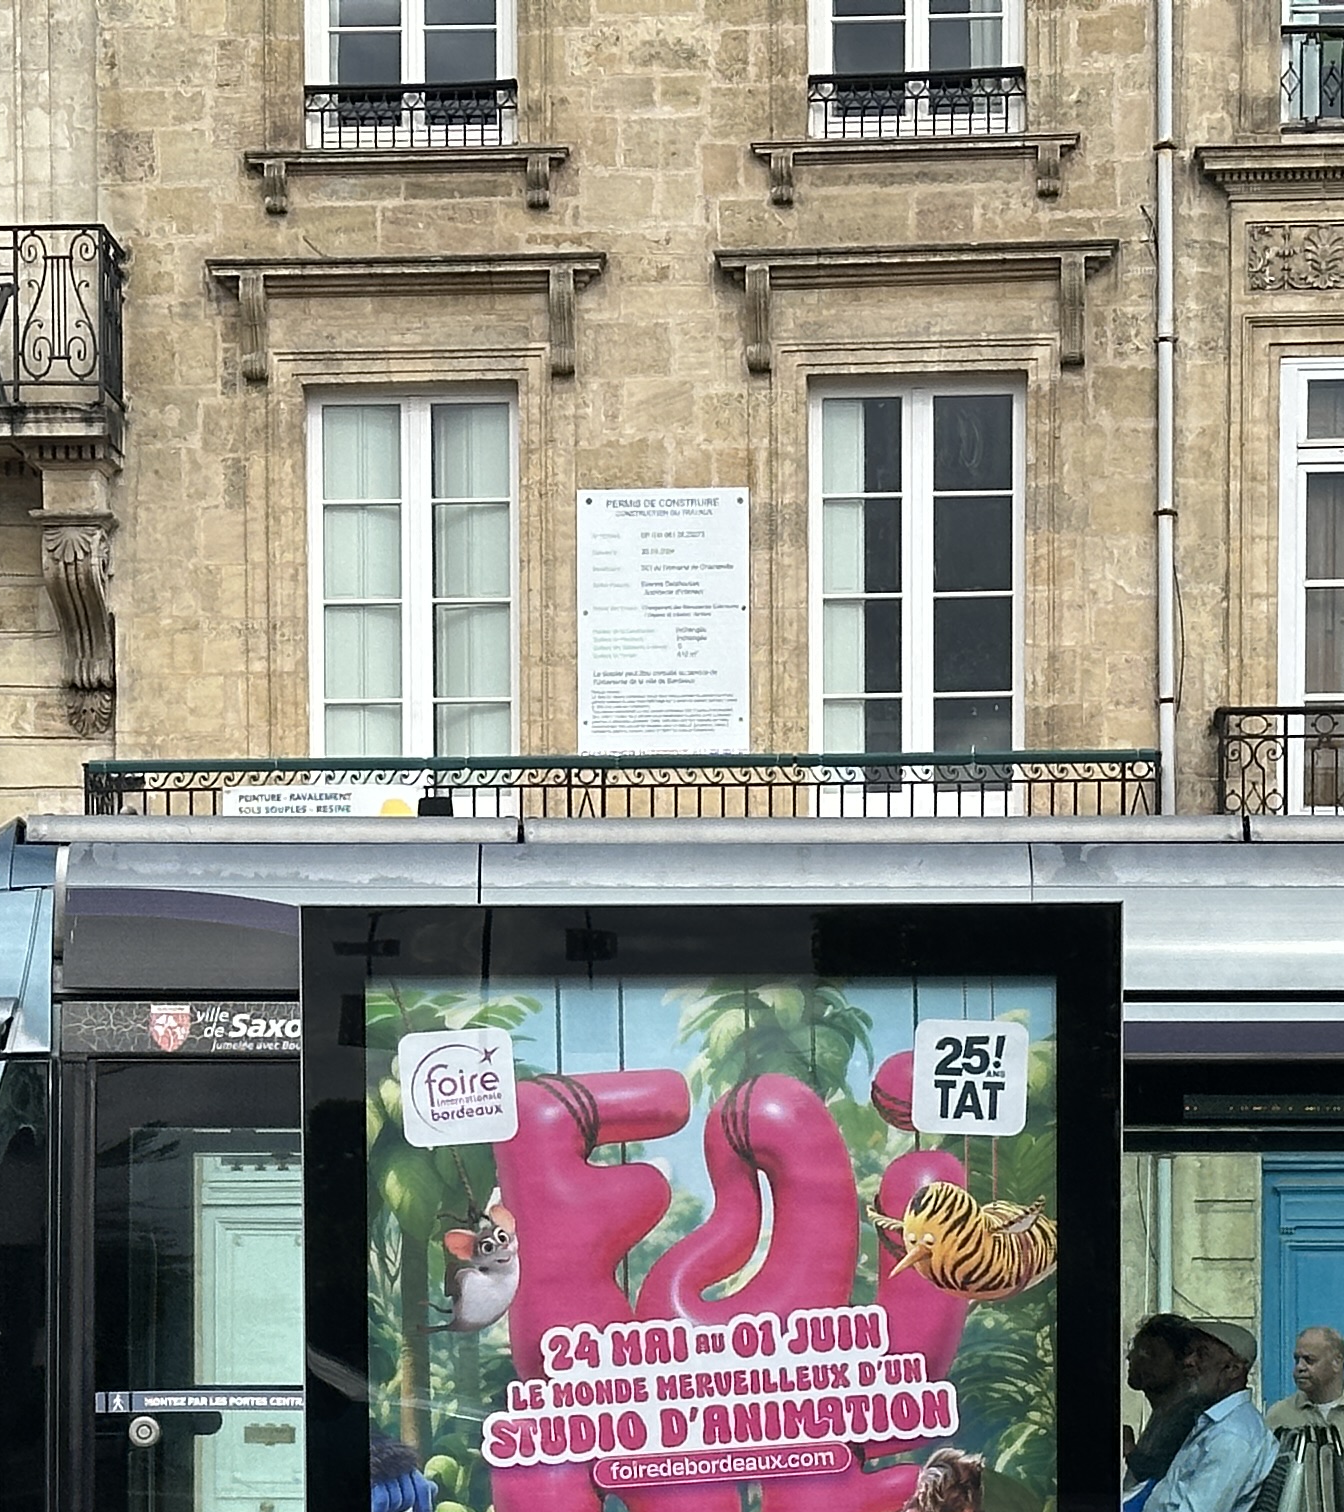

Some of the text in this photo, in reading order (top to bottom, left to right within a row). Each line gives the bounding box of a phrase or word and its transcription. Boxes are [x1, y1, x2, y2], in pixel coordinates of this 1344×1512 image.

[644, 499, 657, 507] DE
[238, 793, 282, 802] PEINTURE
[289, 793, 352, 801] RAVALEMENT
[265, 805, 307, 814] SOUPLES
[197, 1006, 230, 1023] ville
[203, 1013, 302, 1038] de Saxo
[256, 1041, 280, 1050] avec
[934, 1035, 1006, 1076] 25!
[986, 1070, 1006, 1078] ANS
[425, 1064, 500, 1107] foire
[437, 1092, 503, 1107] internationale
[934, 1079, 1006, 1120] TAT
[431, 1105, 504, 1121] bordeaux
[548, 1312, 882, 1371] 24 MAI AU 01 JUIN
[512, 1358, 922, 1411] LE MONDE MERVEILLEUX D'UN
[144, 1396, 186, 1407] MONTEZ
[188, 1396, 208, 1407] PAR
[209, 1396, 228, 1407] LES
[229, 1396, 268, 1407] PORTES
[490, 1389, 952, 1459] STUDIO D'ANIMATION
[610, 1450, 835, 1480] foiredebordeaux.com
